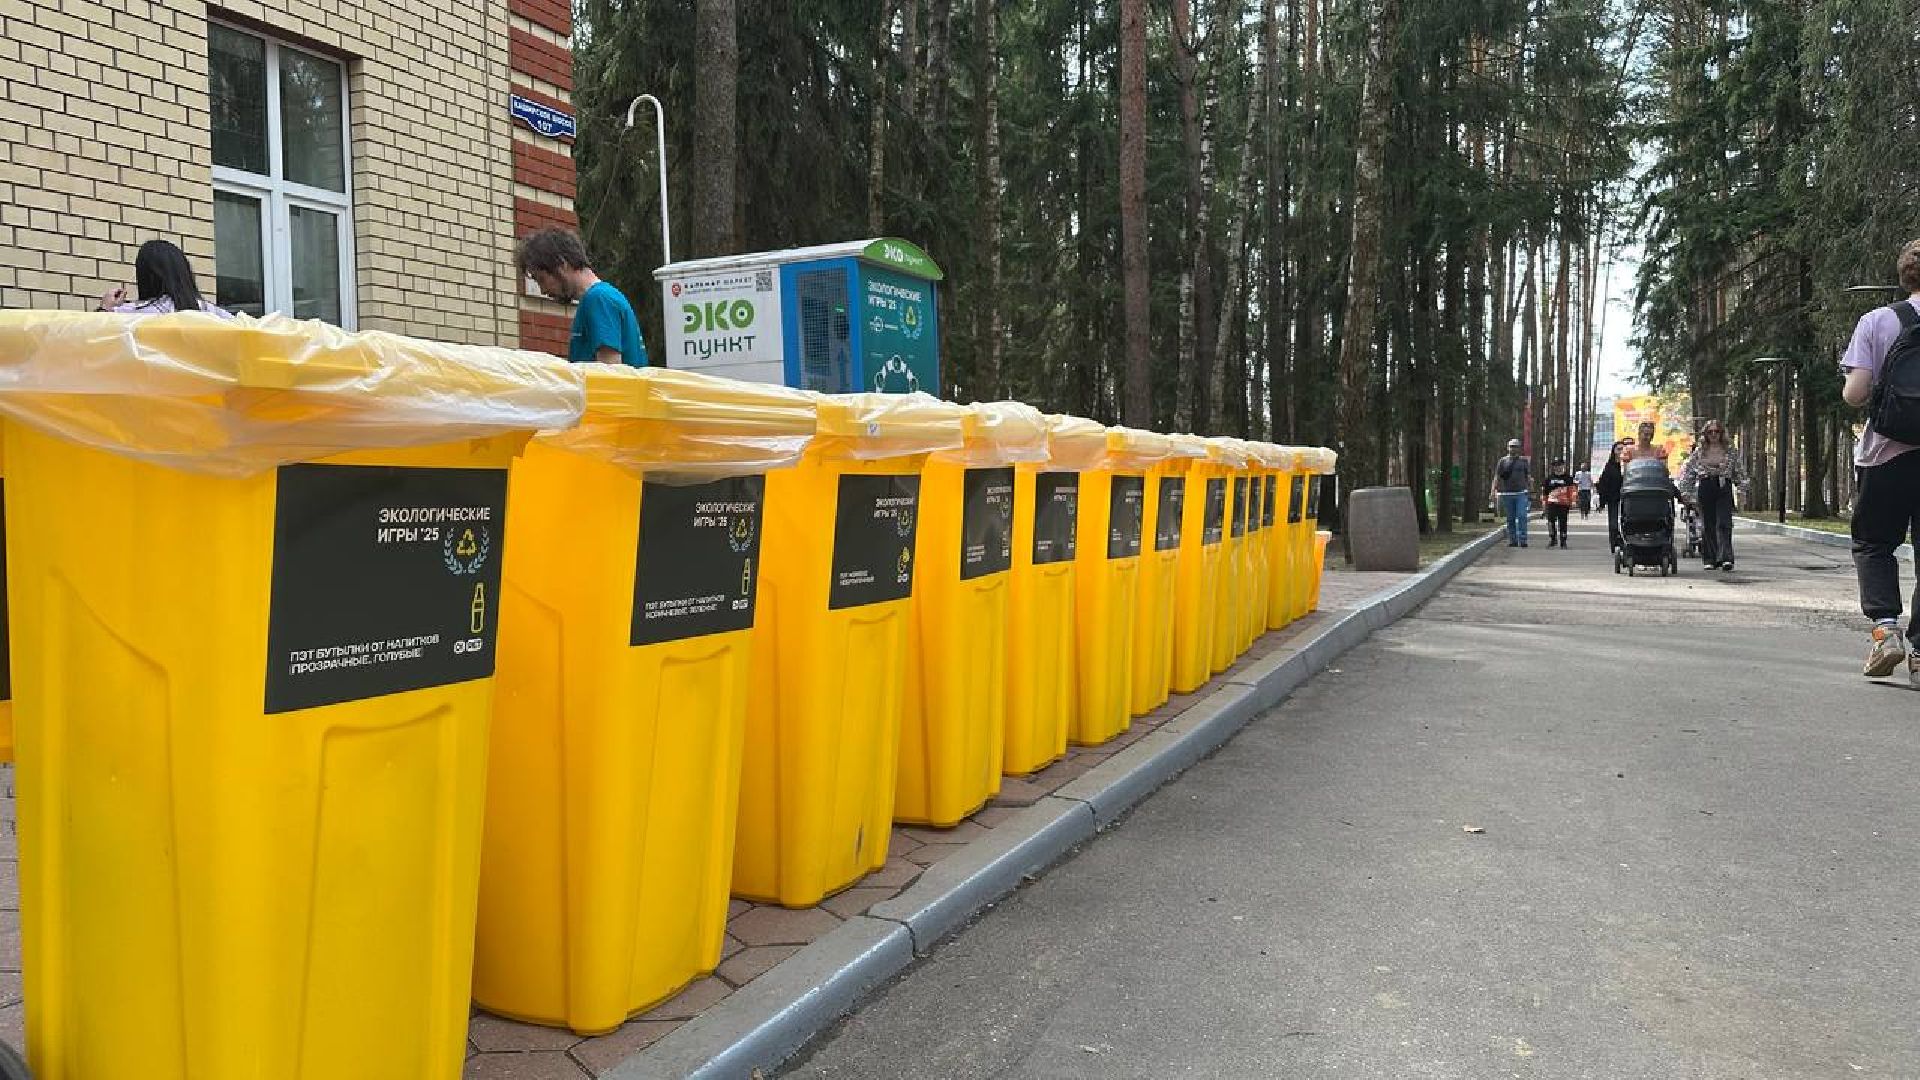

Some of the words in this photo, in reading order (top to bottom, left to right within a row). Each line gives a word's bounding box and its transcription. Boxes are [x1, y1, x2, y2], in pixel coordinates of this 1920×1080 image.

[537, 120, 552, 132] 107
[884, 243, 903, 262] ЭКО
[682, 299, 755, 333] ЭКО
[378, 507, 491, 523] ЭКОЛОГИЧЕСКИЕ
[377, 528, 418, 544] ИГРЫ
[290, 649, 316, 662] ПЭТ
[316, 644, 370, 659] БУТЫЛКИ
[371, 641, 385, 652] ОТ
[386, 633, 440, 650] НАПИТКОВ
[373, 647, 422, 663] ГОЛУБЫЕ
